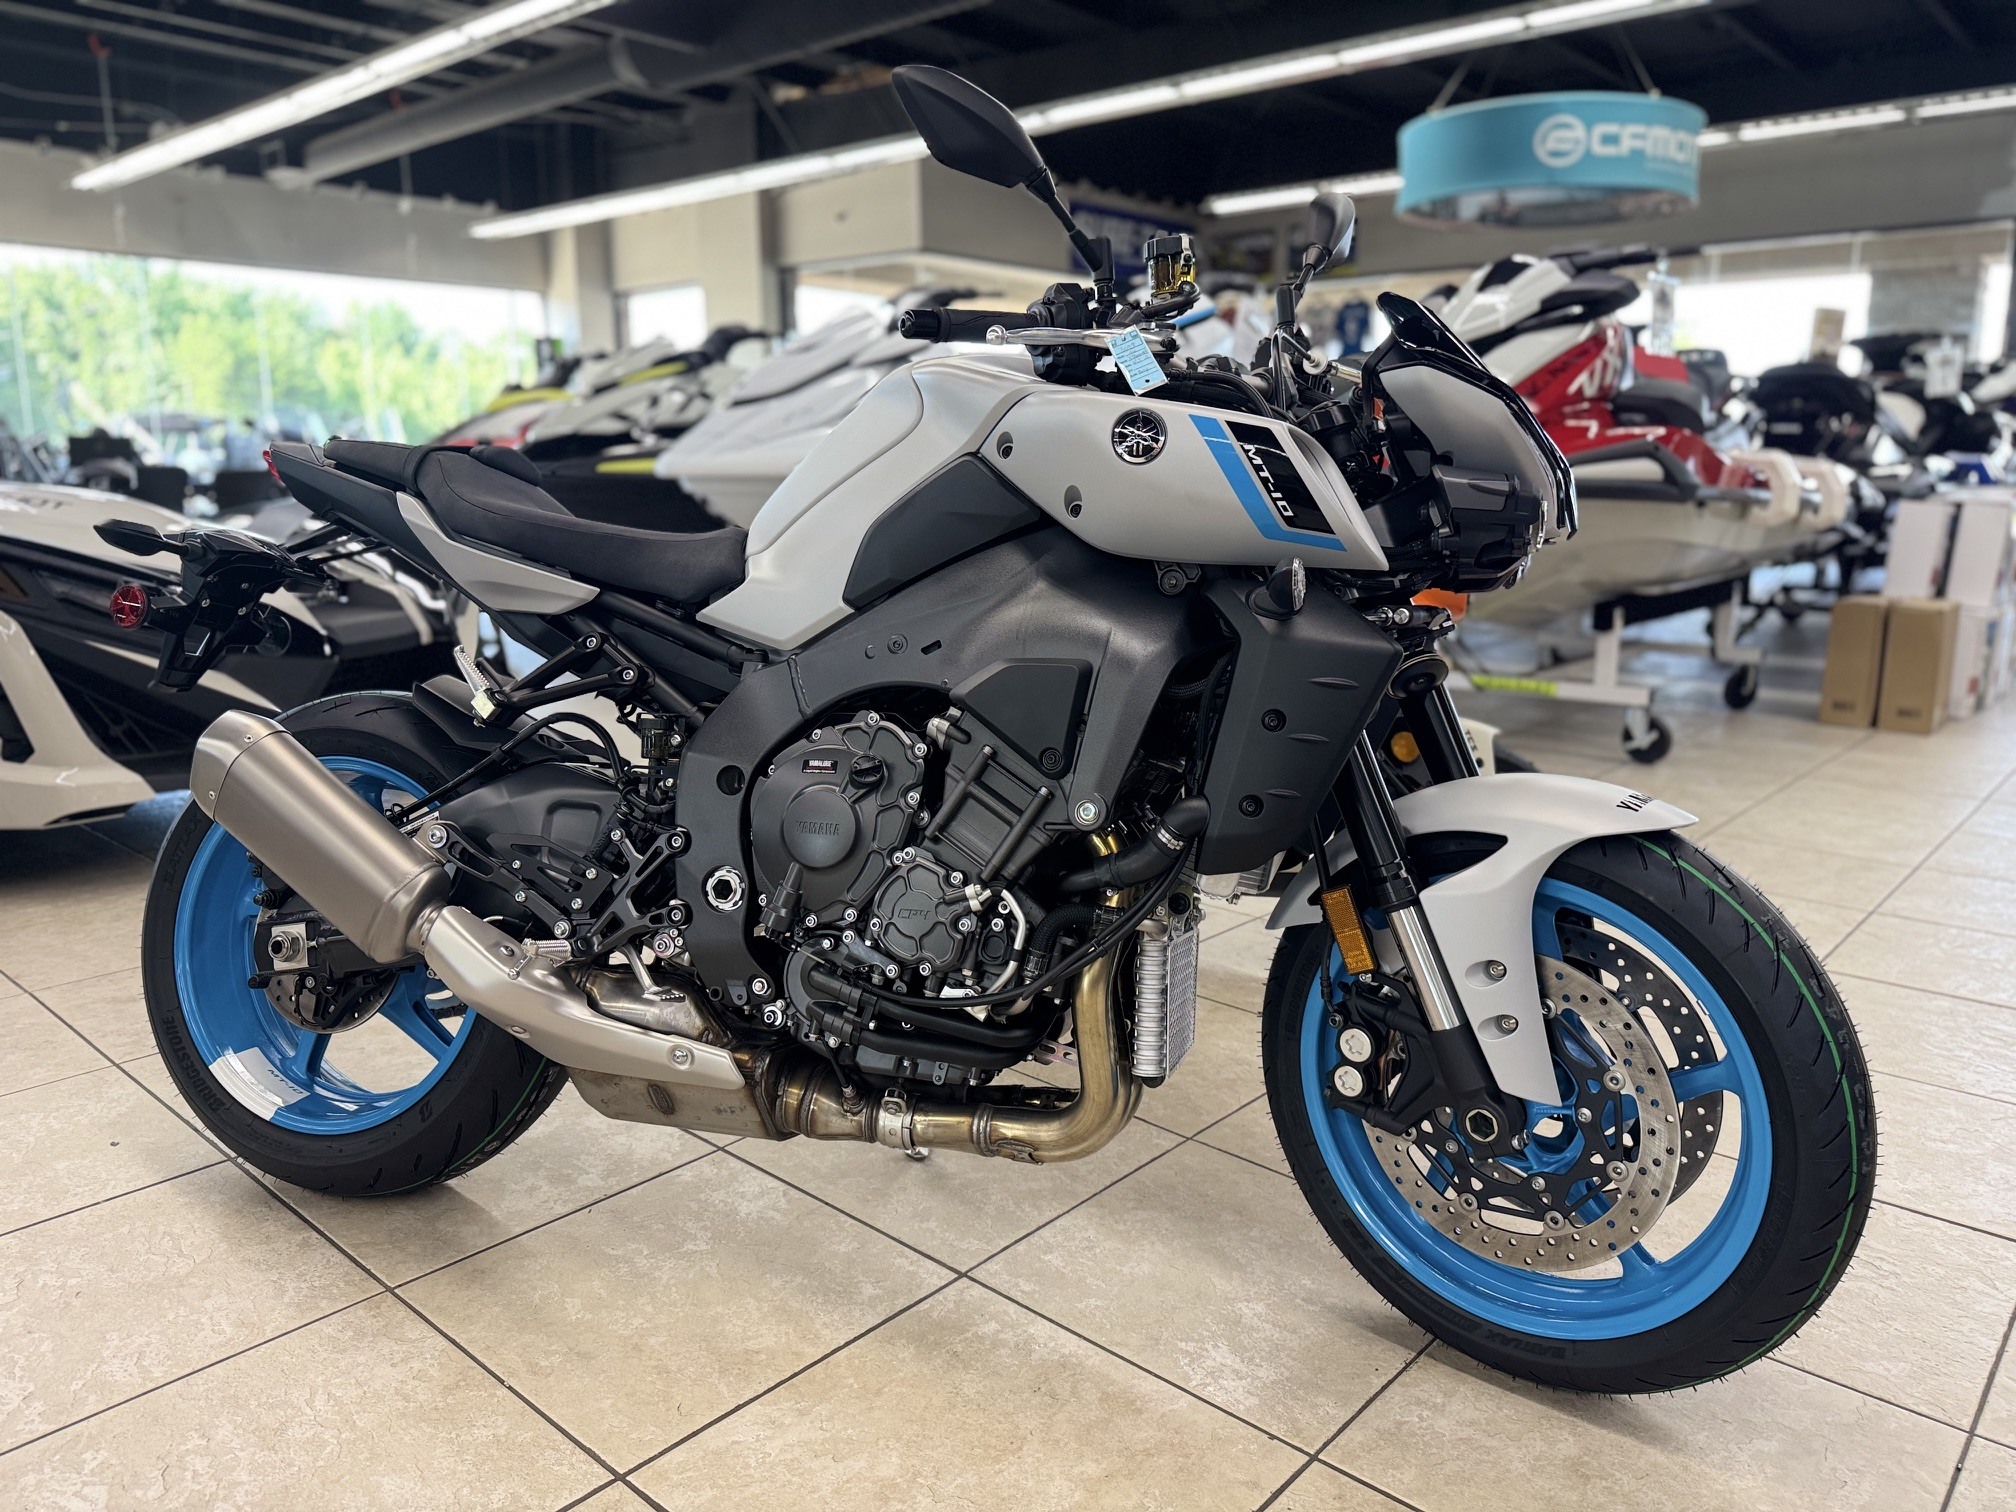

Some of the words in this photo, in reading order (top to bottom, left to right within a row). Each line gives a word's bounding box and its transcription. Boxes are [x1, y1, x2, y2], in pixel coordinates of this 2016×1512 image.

[1240, 444, 1294, 517] MT-10
[793, 820, 840, 836] YAMAHA
[161, 1014, 227, 1112] BRIDGESTONE
[267, 1069, 304, 1095] MT-10
